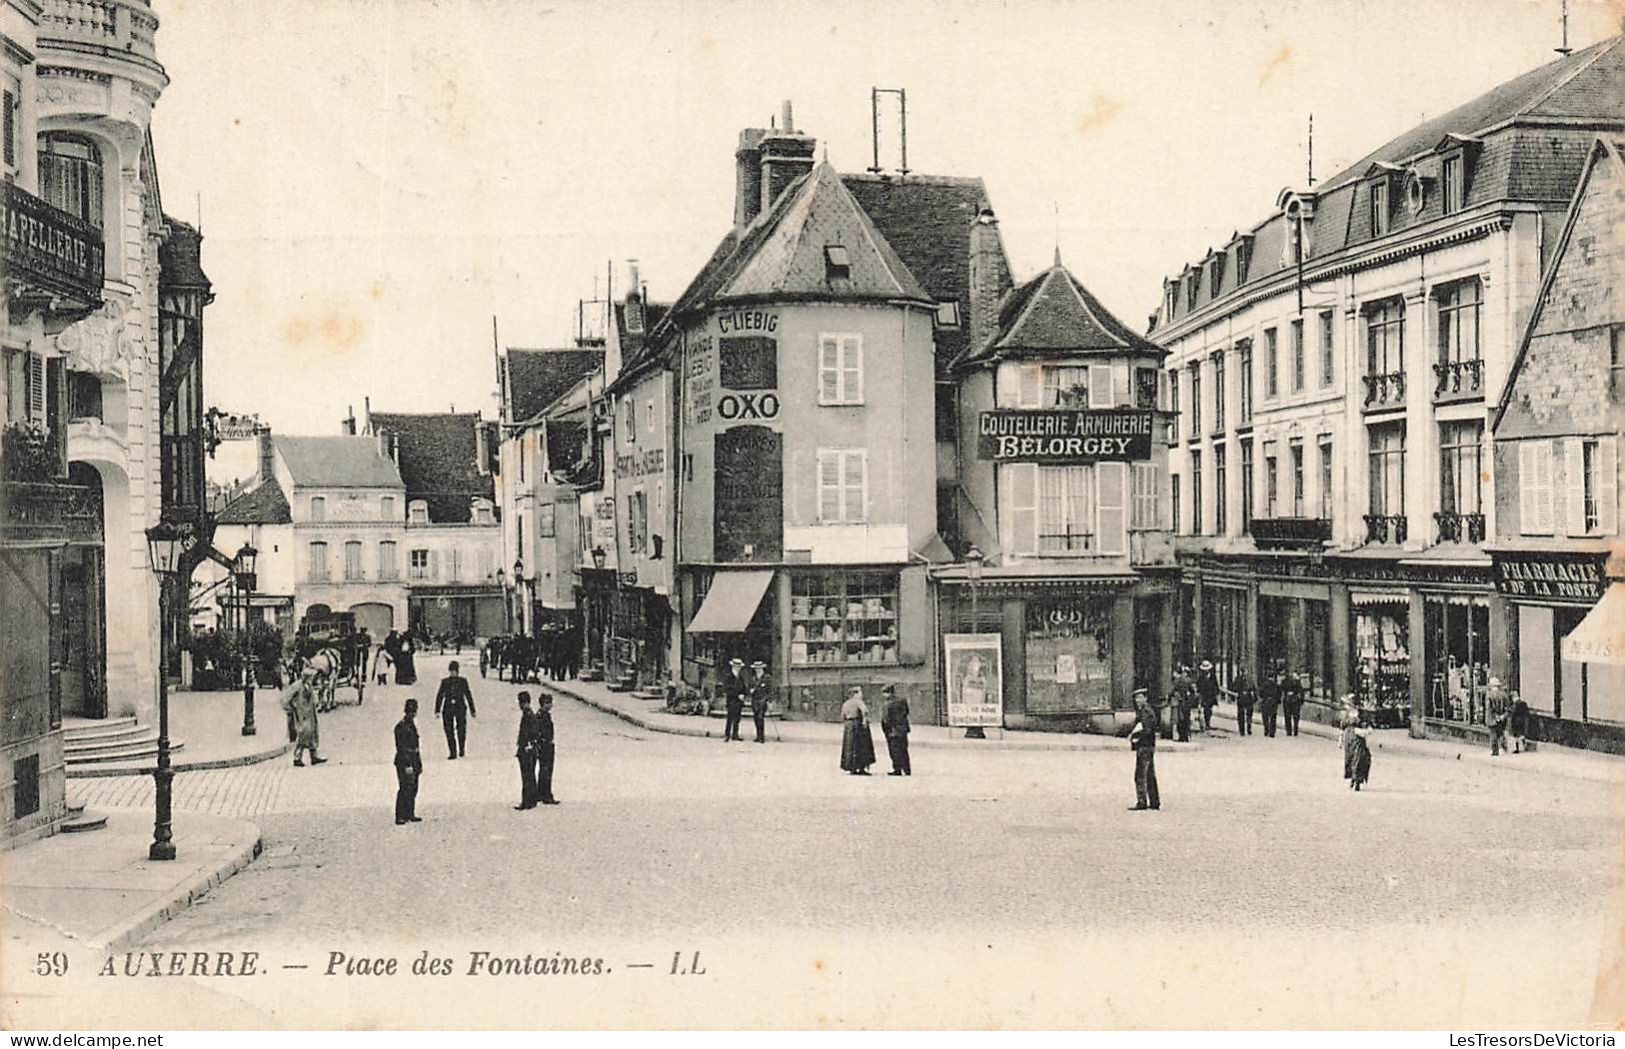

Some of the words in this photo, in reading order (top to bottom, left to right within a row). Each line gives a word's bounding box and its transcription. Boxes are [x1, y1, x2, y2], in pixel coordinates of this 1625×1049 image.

[732, 311, 778, 333] LIEBIG
[717, 393, 780, 419] OXO
[1072, 412, 1150, 436] ARMURERIE
[1500, 562, 1600, 583] PHARMACIE
[1510, 580, 1526, 595] DE
[1533, 581, 1552, 596] LA
[1557, 582, 1600, 598] POSTE
